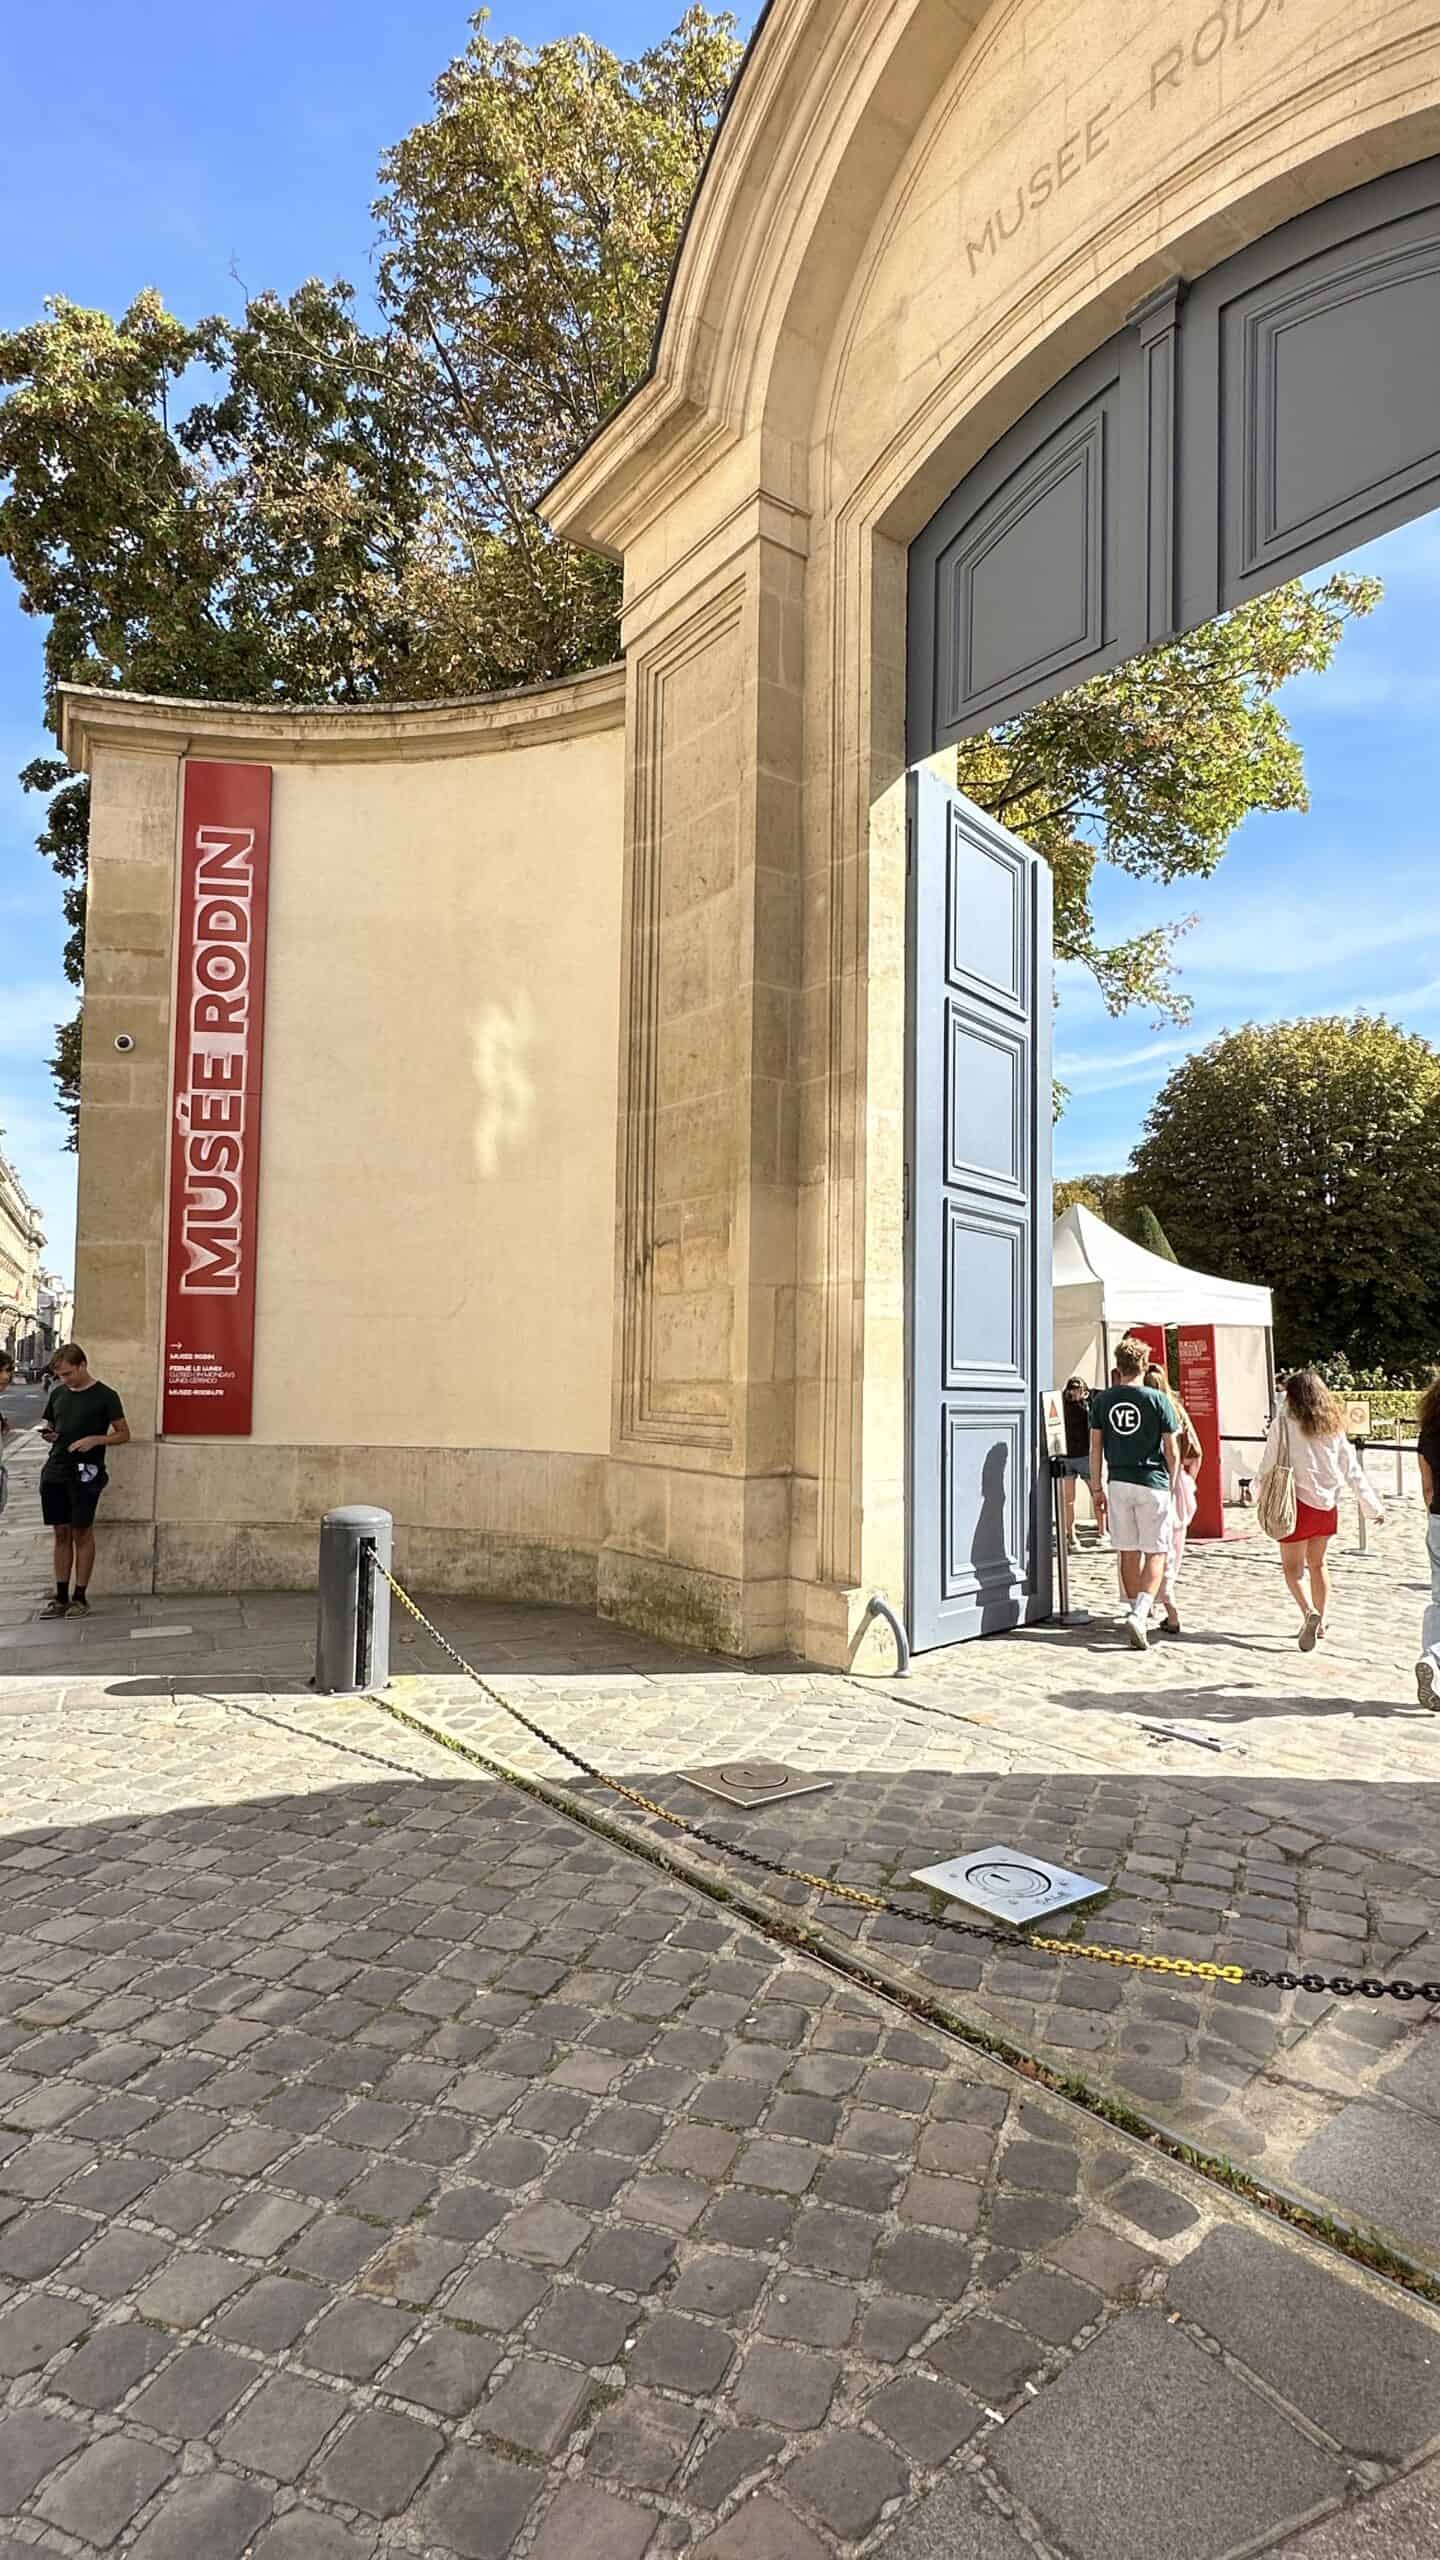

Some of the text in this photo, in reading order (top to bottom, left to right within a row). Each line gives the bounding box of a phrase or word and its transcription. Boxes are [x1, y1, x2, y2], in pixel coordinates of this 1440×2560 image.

[966, 0, 1284, 278] MUSEE ROD
[177, 826, 254, 1293] MUSÉE RODIN
[1115, 1410, 1136, 1428] YE
